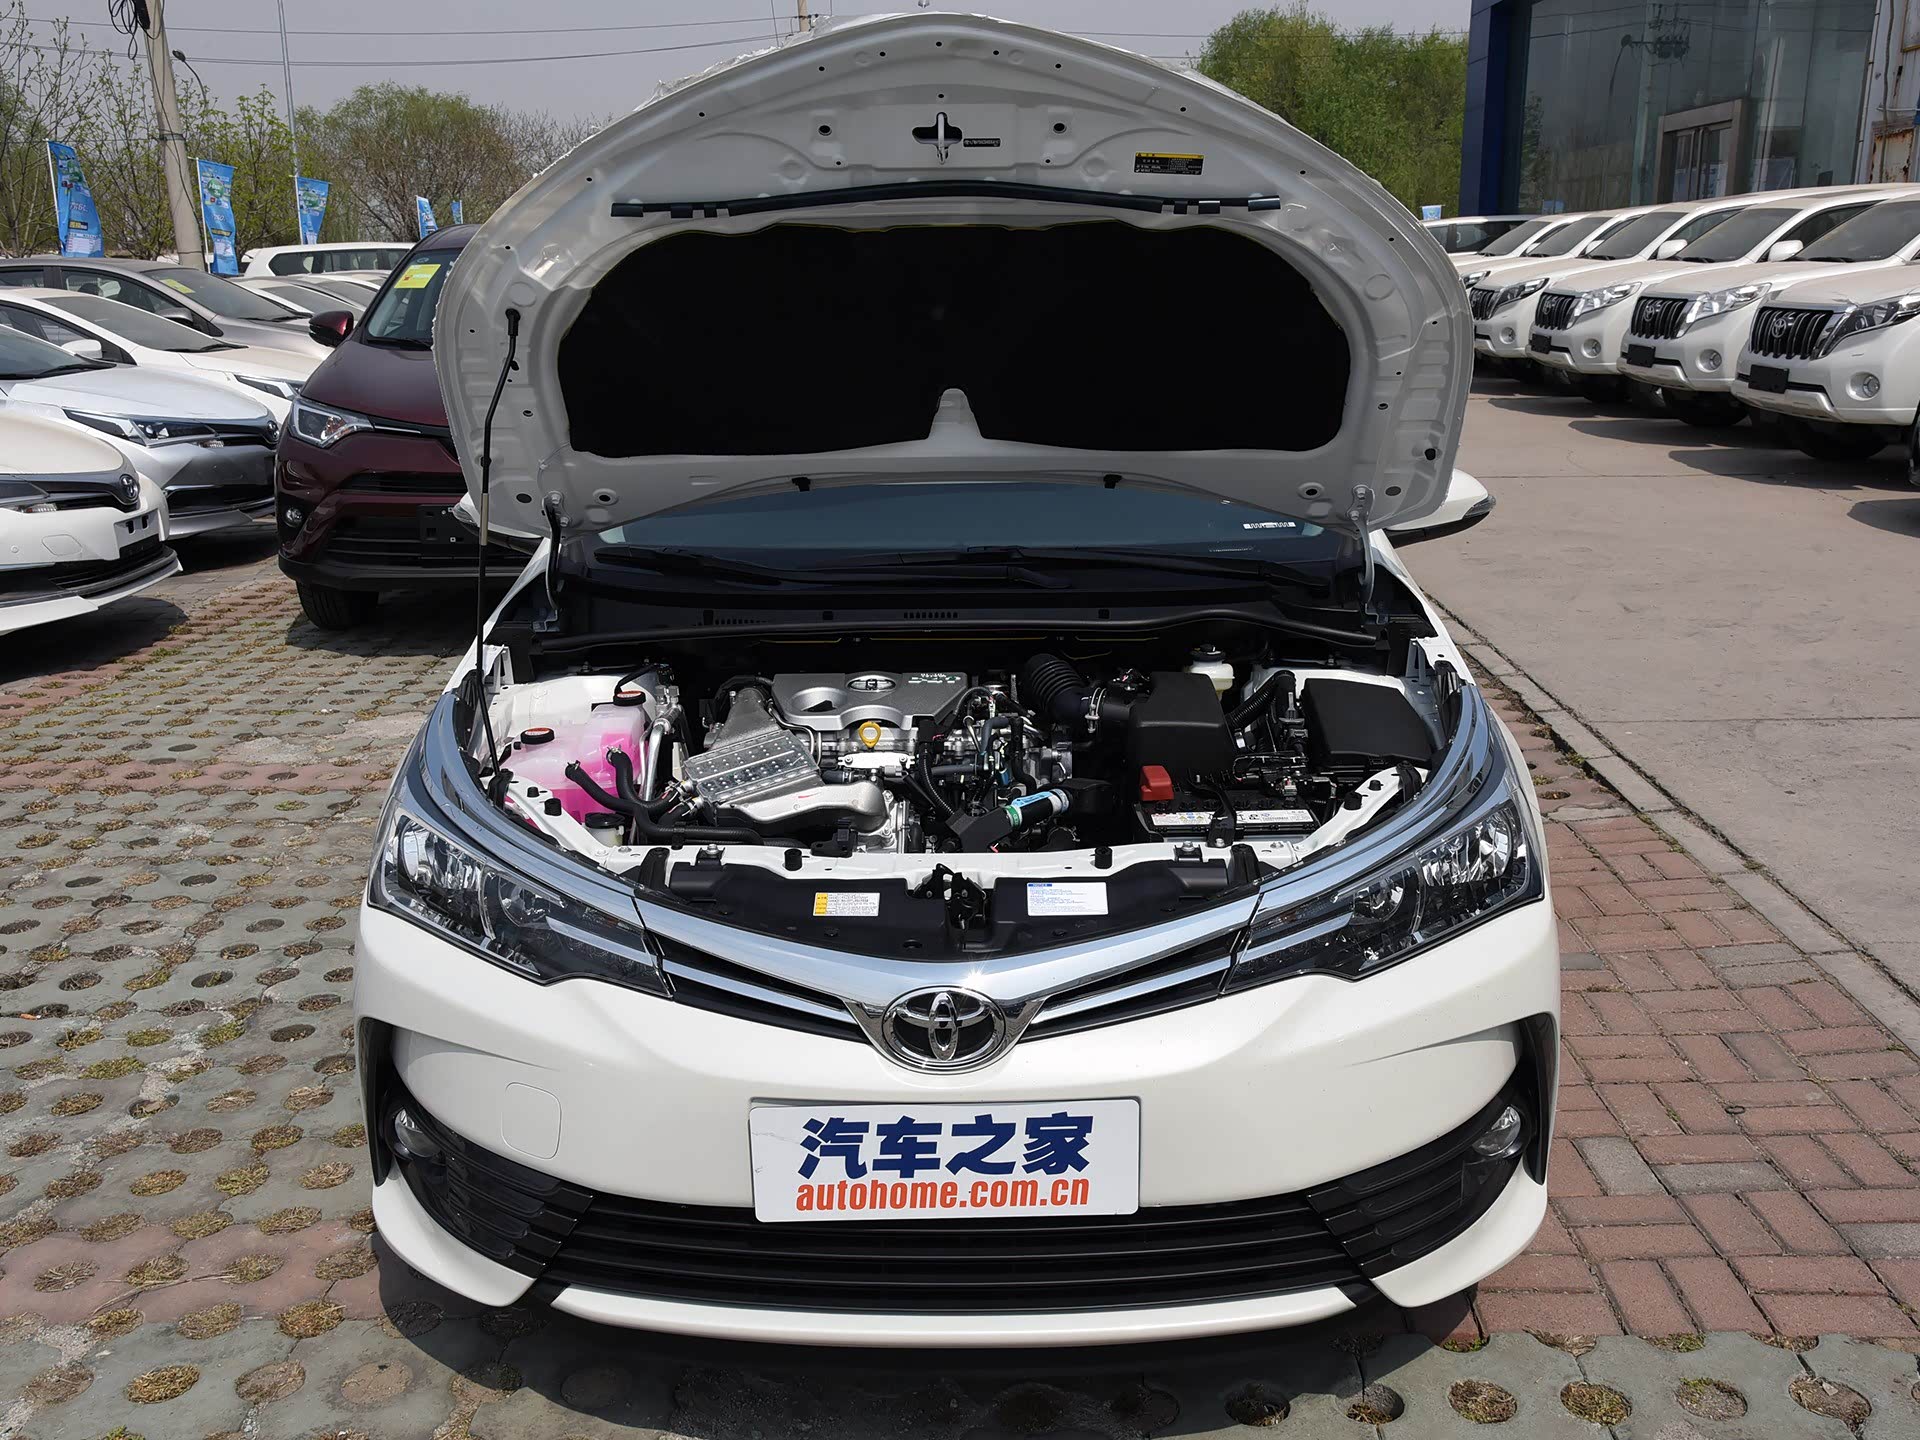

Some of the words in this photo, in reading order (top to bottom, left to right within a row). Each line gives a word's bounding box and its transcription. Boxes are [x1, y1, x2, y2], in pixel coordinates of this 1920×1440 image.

[799, 1112, 1094, 1179] 汽车之家
[797, 1178, 1089, 1211] autohome.com.cn
